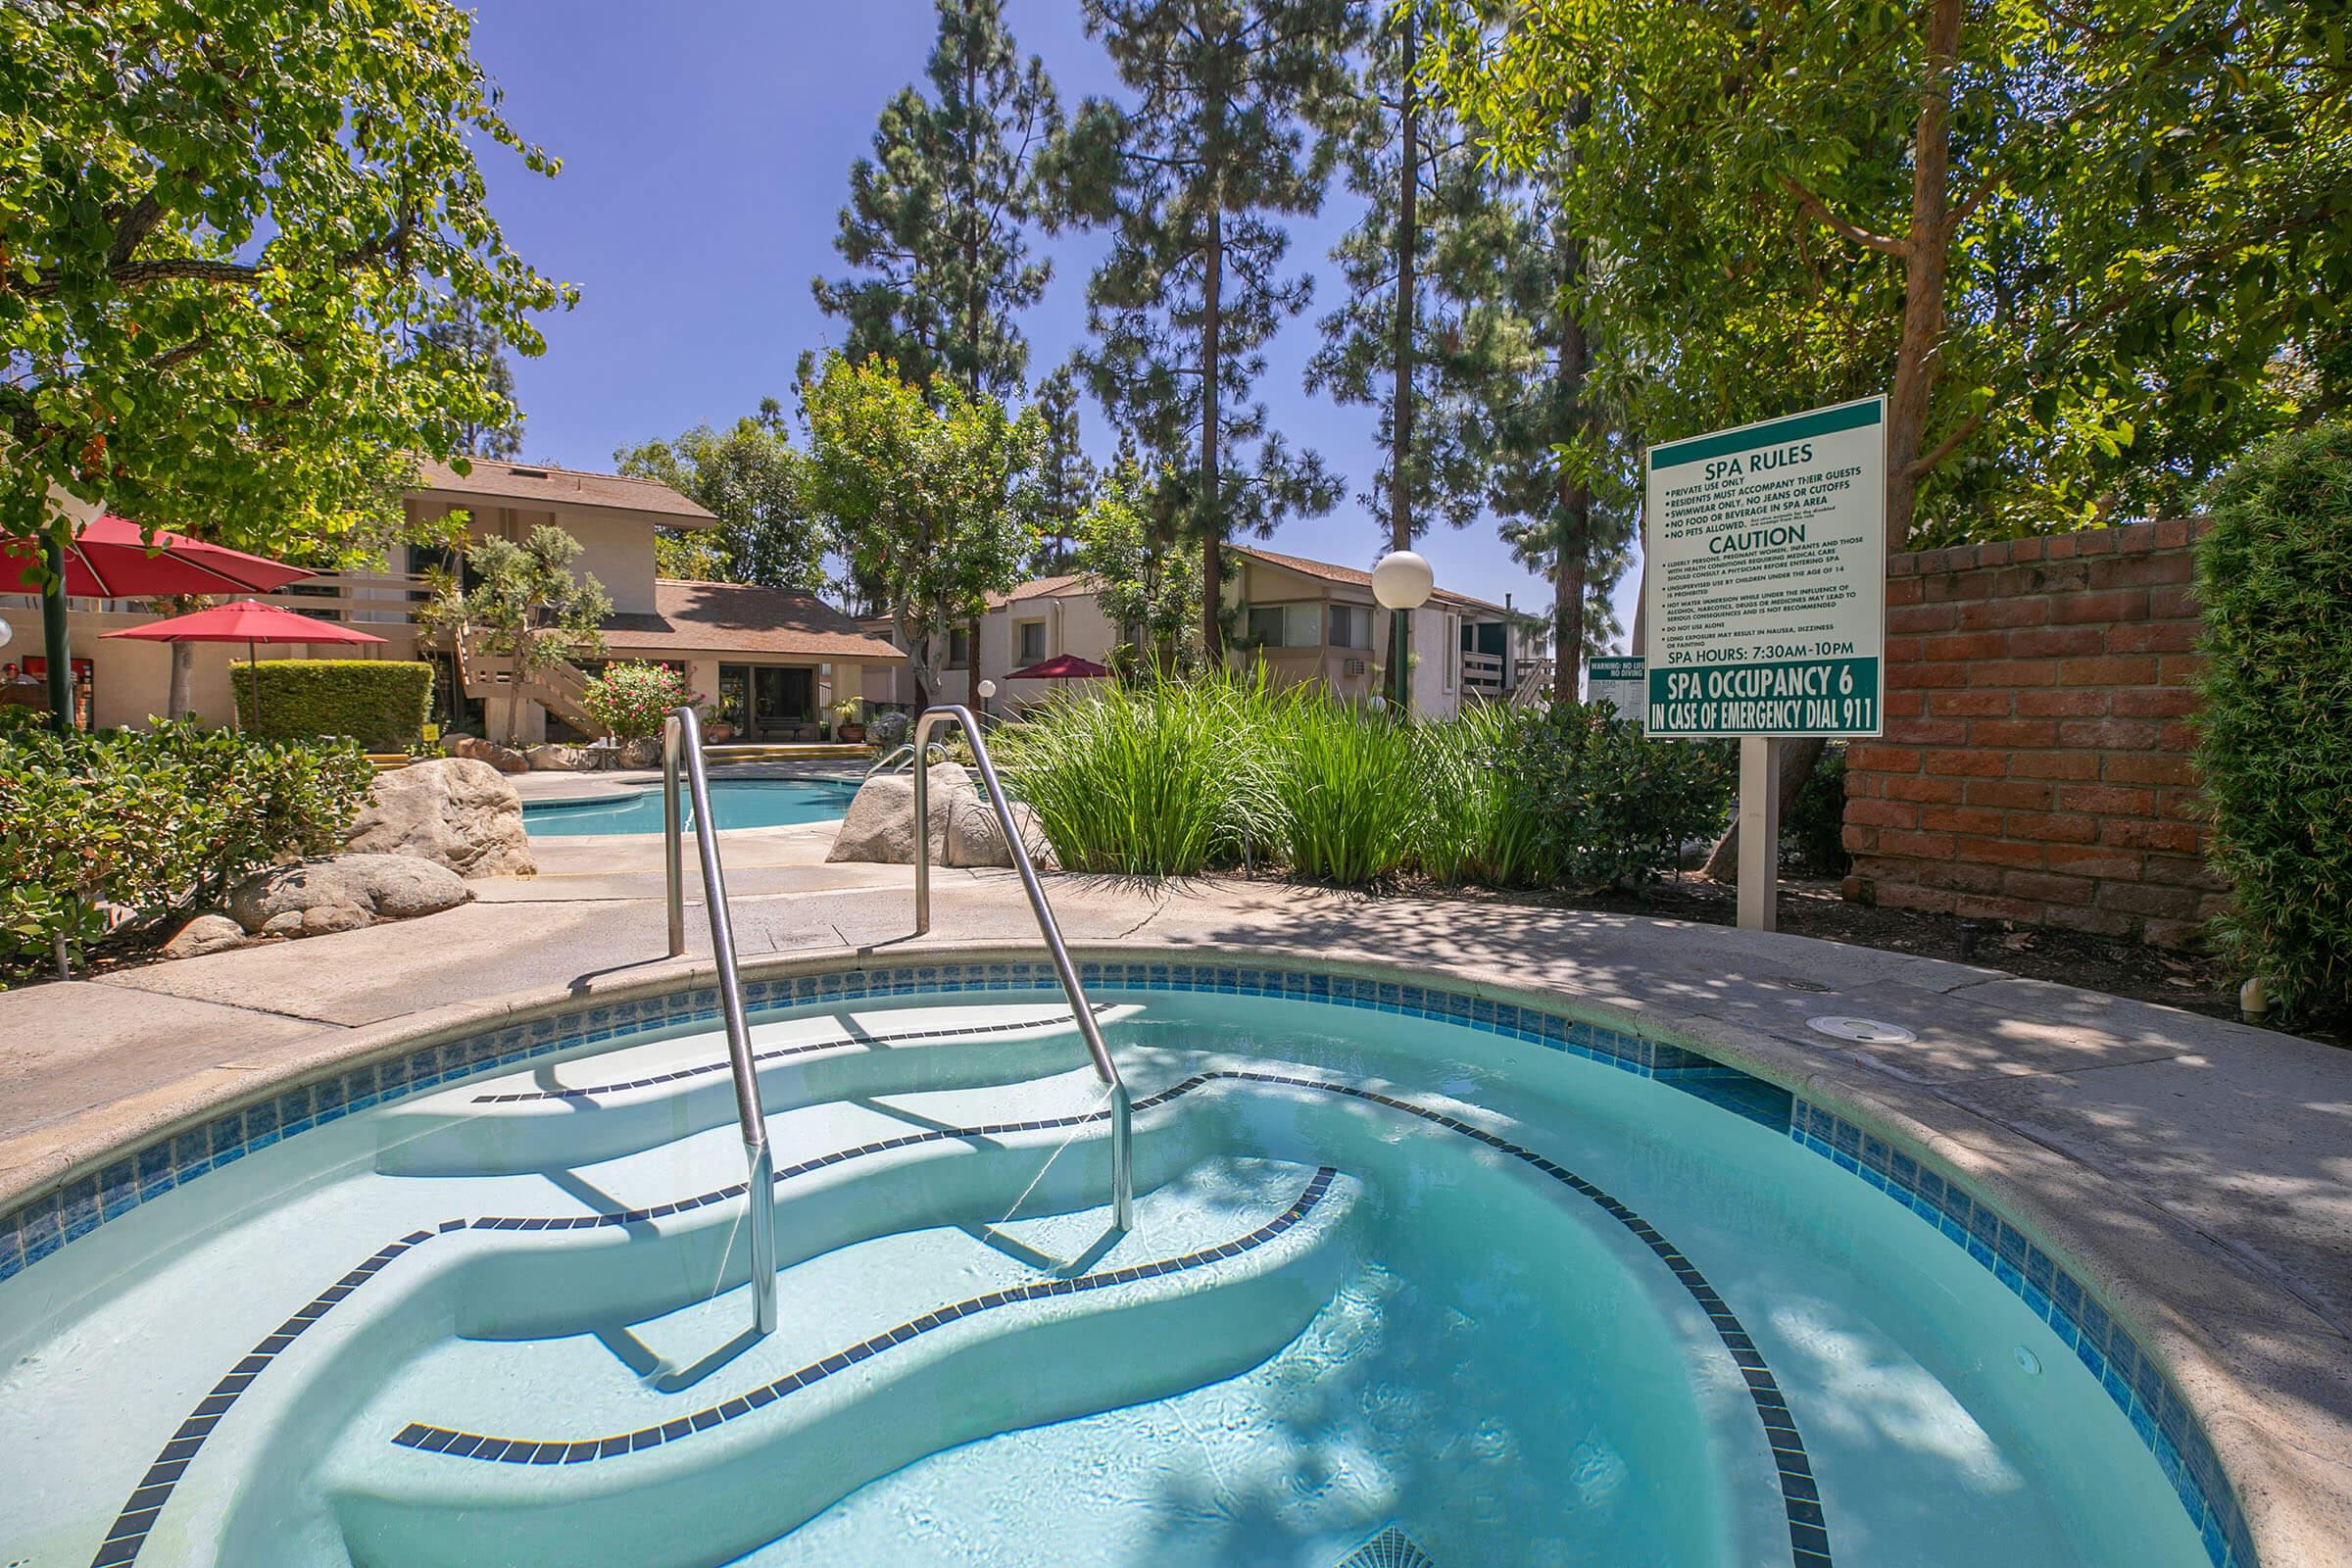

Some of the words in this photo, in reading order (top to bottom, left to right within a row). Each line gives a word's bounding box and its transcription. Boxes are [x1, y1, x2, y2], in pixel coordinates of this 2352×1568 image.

[1705, 459, 1742, 480] SPA
[1750, 444, 1813, 471] RULES
[1671, 484, 1702, 497] PRIVATE
[1704, 481, 1719, 491] USE
[1722, 477, 1744, 488] ONLY
[1671, 494, 1711, 508] RESIDENTS
[1714, 490, 1739, 500] MUST
[1739, 478, 1794, 495] ACCOMPANY
[1797, 473, 1823, 485] THEIR
[1826, 466, 1861, 480] GUESTS
[1671, 504, 1715, 518] SWIMWEAR
[1718, 500, 1743, 510] ONLY,
[1746, 496, 1760, 505] NO
[1764, 491, 1790, 502] JEANS
[1793, 488, 1807, 497] OR
[1810, 480, 1850, 494] CUTOFFS
[1671, 519, 1684, 528] NO
[1686, 515, 1708, 525] FOOD
[1711, 513, 1723, 521] OR
[1725, 506, 1768, 519] BEVERAGE
[1784, 500, 1800, 511] SPA
[1803, 496, 1828, 507] AREA
[1671, 530, 1684, 539] NO
[1686, 527, 1703, 537] PETS
[1705, 521, 1747, 534] ALLOWED.
[1709, 524, 1805, 554] CAUTION
[1790, 542, 1820, 552] INFANTS
[1707, 561, 1746, 569] CONDITIONS
[1728, 565, 1762, 574] PHYSICIAN
[1790, 558, 1824, 566] ENTERING
[1667, 582, 1710, 591] UNSUPERVISED
[1674, 589, 1708, 598] PROHIBITED
[1702, 596, 1739, 605] IMMERSION
[1799, 585, 1837, 595] INFLUENCE
[1770, 596, 1806, 605] MEDICINES
[1692, 611, 1741, 620] CONSEQUENCES
[1784, 602, 1837, 612] RECOMMENDED
[1797, 623, 1834, 632] DIZZINESS
[1668, 651, 1692, 664] SPA
[1696, 647, 1747, 662] HOURS:
[1752, 642, 1854, 660] 7:30AM-10PM
[1668, 672, 1702, 700] SPA
[1708, 666, 1833, 699] OCCUPANCY
[1839, 664, 1853, 695] 6
[1652, 704, 1665, 730] IN
[1668, 702, 1697, 730] CASE
[1700, 702, 1718, 729] OF
[1721, 700, 1802, 729] EMERGENCY
[1806, 699, 1839, 729] DIAL
[1843, 698, 1872, 728] 911
